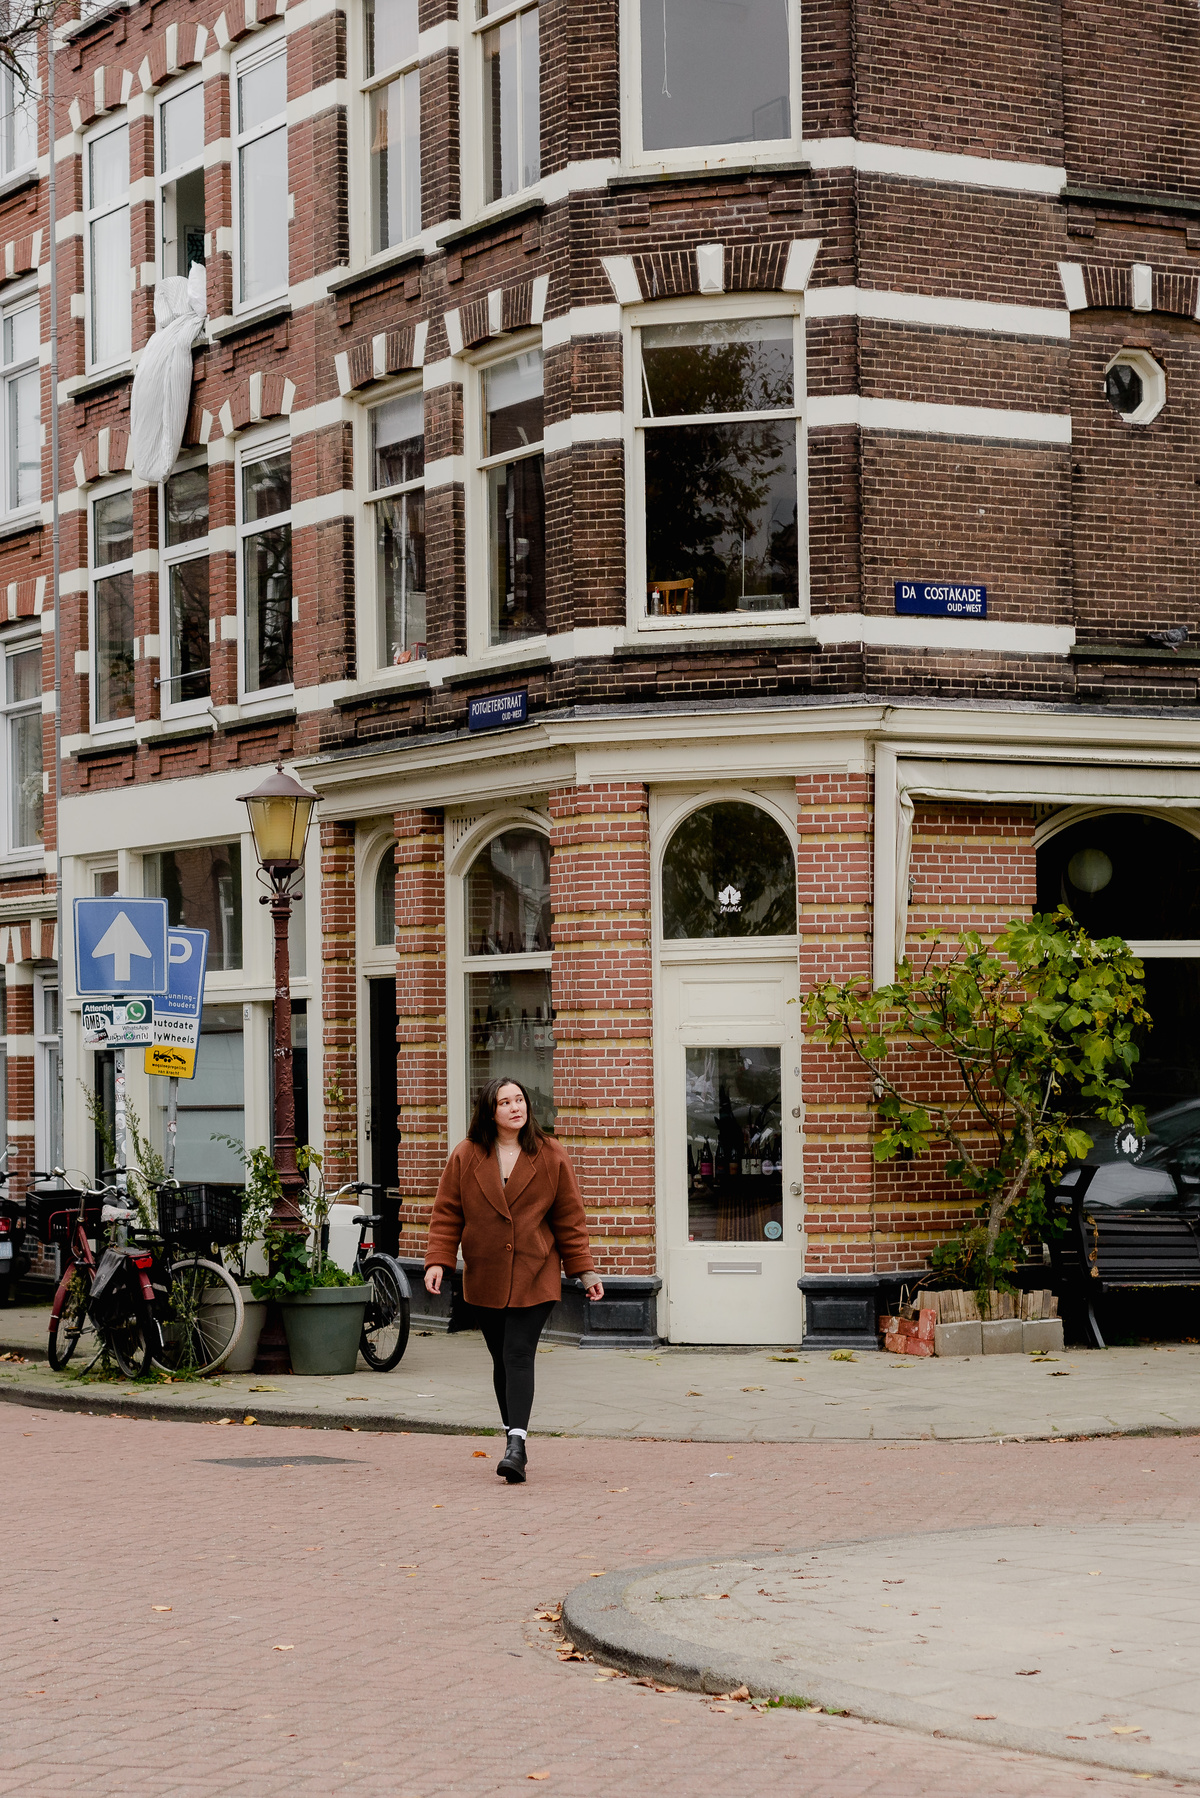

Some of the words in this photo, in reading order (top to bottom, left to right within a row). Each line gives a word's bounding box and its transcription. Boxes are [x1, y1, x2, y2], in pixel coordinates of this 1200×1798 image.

[902, 585, 917, 599] DA
[924, 586, 982, 602] COSTAKADE
[947, 602, 982, 613] OUD-WEST
[471, 694, 523, 716] POTGIETERSTRAAT
[501, 709, 523, 721] OUD-WEST
[168, 936, 193, 964] P
[168, 1000, 196, 1010] houders
